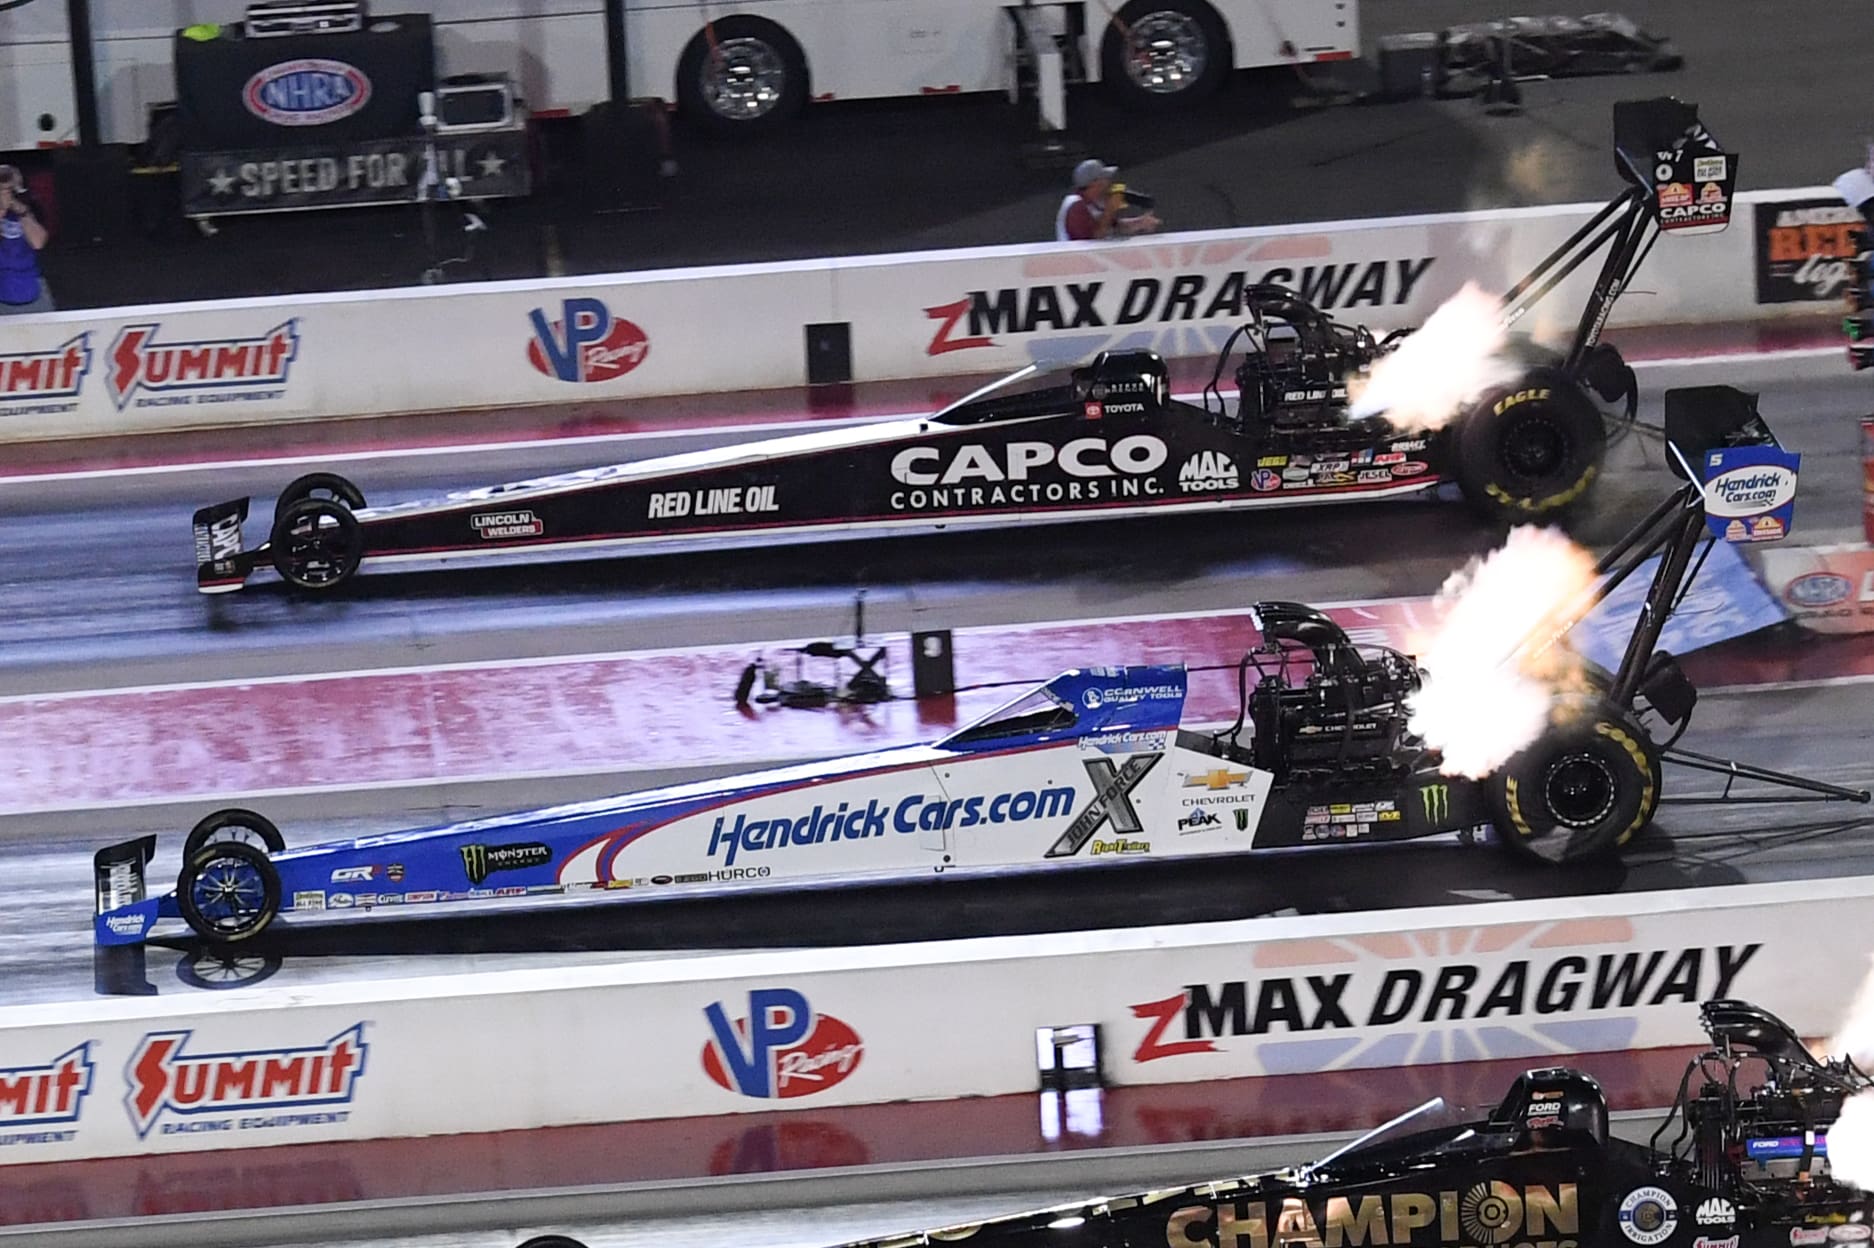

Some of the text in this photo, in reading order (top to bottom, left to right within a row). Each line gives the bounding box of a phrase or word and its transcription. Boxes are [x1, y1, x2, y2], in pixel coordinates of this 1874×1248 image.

[263, 72, 351, 109] NHRA
[237, 157, 339, 196] SPEED
[349, 152, 408, 188] FOR
[1660, 203, 1726, 218] CAPCO
[528, 297, 611, 382] VP
[197, 390, 286, 404] EQUIPMENT
[1493, 389, 1550, 416] EAGLE
[1104, 403, 1145, 414] TOYOTA
[890, 434, 1168, 486] CAPCO
[1178, 450, 1240, 482] MAC
[1709, 454, 1723, 466] 5
[1360, 470, 1392, 480] JESEL
[891, 478, 1164, 509] CONTRACTORS INC.
[1179, 479, 1239, 491] TOOLS
[1715, 472, 1781, 497] Hendrick
[648, 485, 779, 518] RED LINE OIL
[1725, 489, 1777, 503] Cars.com
[475, 513, 529, 527] LINCOLN
[487, 525, 536, 536] WELDERS
[1103, 685, 1183, 696] CORNWELL
[1325, 723, 1377, 732] CHEOLET
[1098, 760, 1143, 810] FORCE
[1182, 794, 1256, 807] CHEVROLET
[1177, 812, 1222, 831] PEAK
[487, 846, 548, 860] MONSTER
[708, 866, 771, 881] HURCO
[1366, 943, 1764, 1026] DRAGWAY
[703, 988, 810, 1098] VP
[778, 1043, 866, 1088] Racing
[1528, 1102, 1561, 1113] FORD
[161, 1111, 352, 1134] RACING EQUIPMENT
[1752, 1141, 1779, 1149] FORD
[1624, 1190, 1672, 1208] CHAMPION
[1696, 1198, 1736, 1217] MAC
[1165, 1180, 1579, 1248] CHAMPION
[1696, 1215, 1736, 1225] TOOLS
[1624, 1222, 1673, 1242] IRRIGATION
